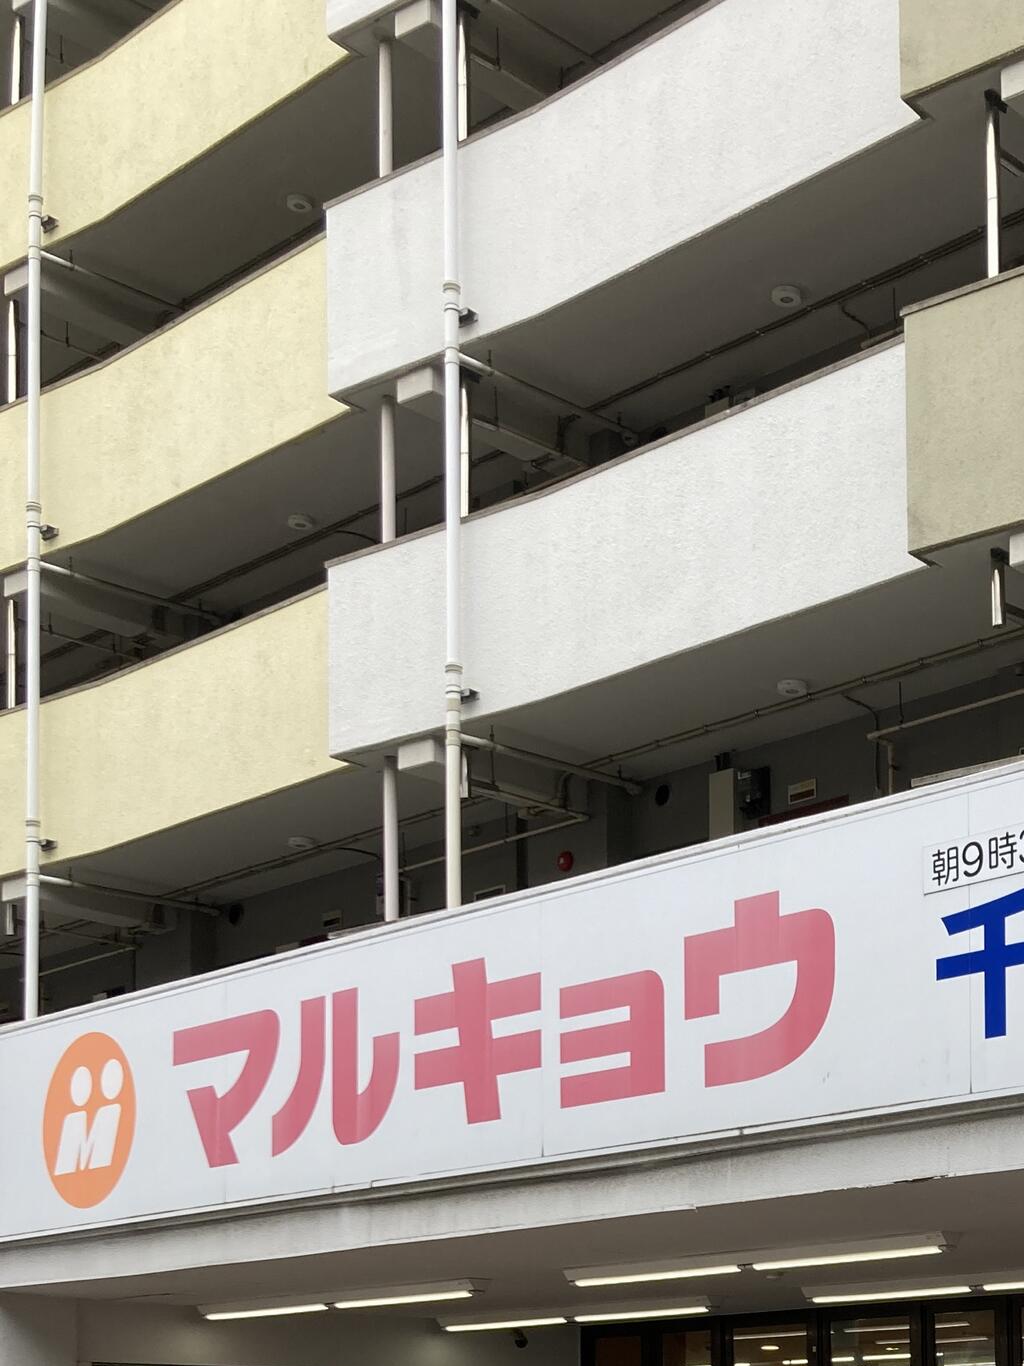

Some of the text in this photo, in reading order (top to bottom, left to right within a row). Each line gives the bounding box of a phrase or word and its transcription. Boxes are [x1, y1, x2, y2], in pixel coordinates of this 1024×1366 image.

[173, 891, 835, 1167] マルキョウ
